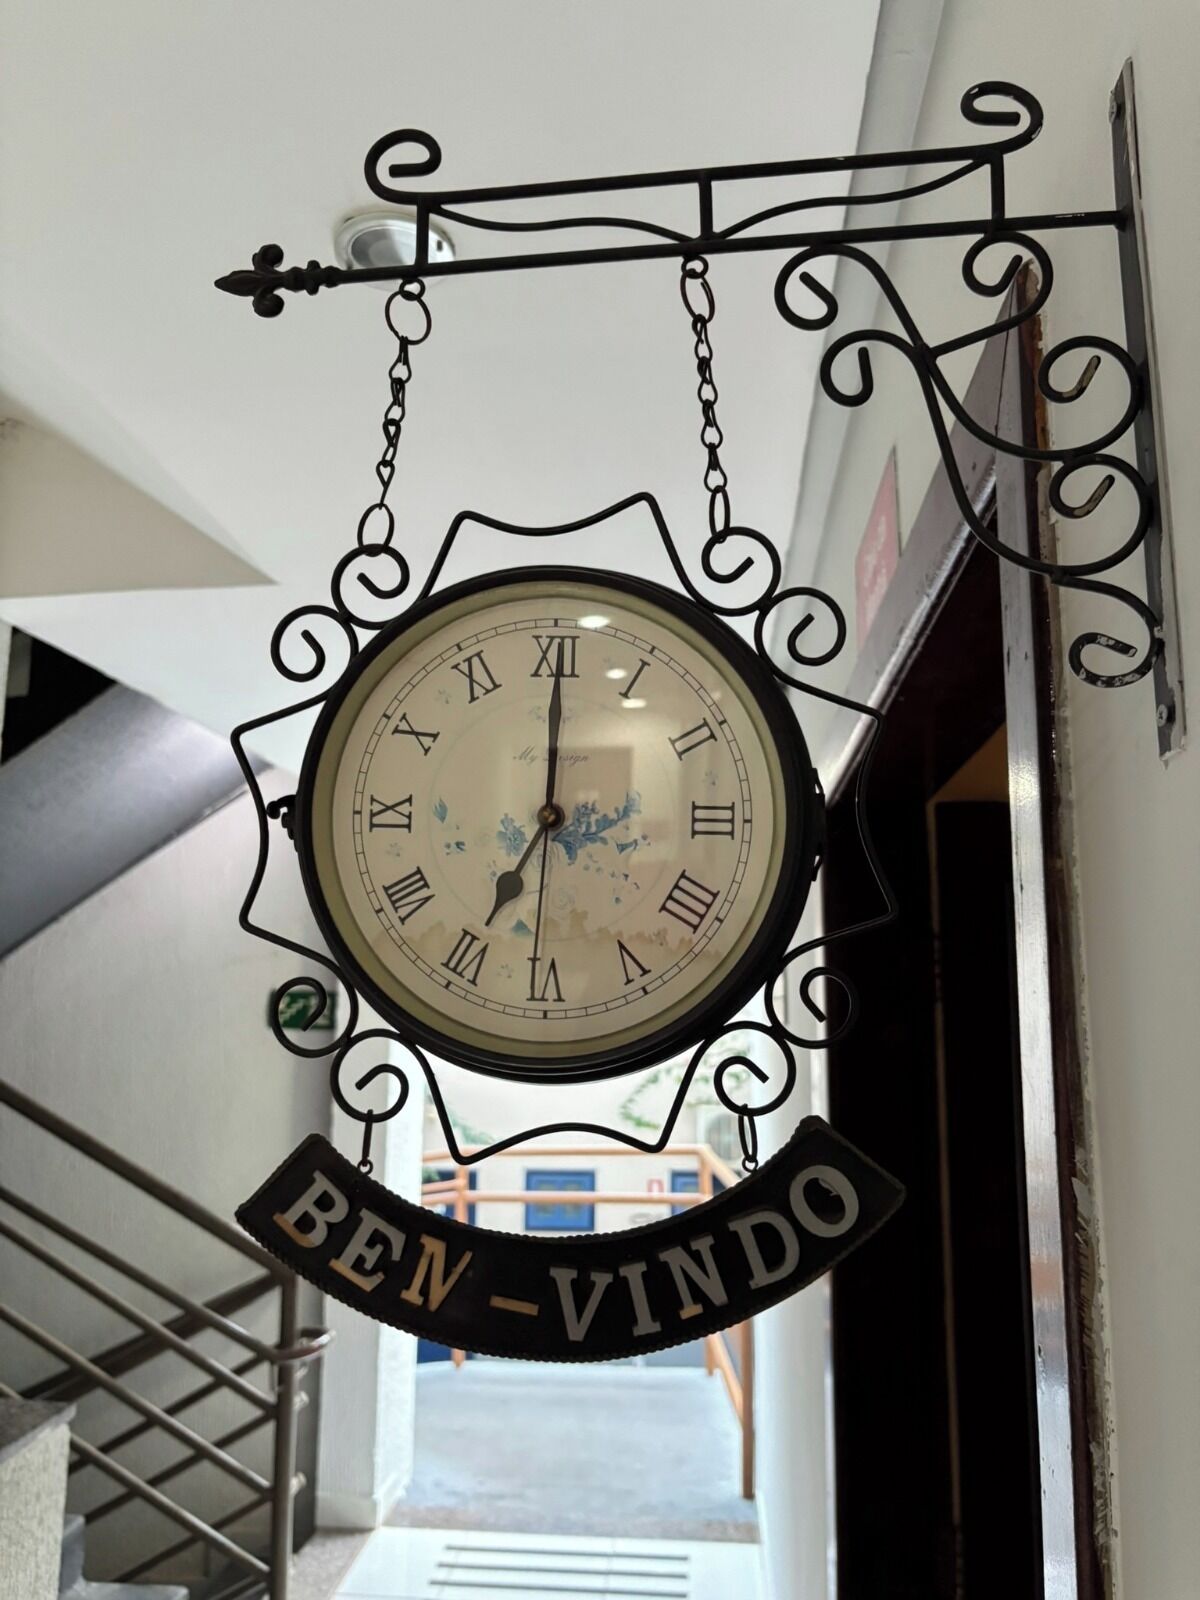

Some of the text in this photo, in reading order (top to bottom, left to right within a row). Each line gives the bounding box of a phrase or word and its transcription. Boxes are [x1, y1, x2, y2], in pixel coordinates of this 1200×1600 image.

[451, 650, 502, 703] XI
[530, 635, 580, 678] XII
[620, 659, 650, 698] I
[392, 713, 440, 756] X
[669, 718, 717, 760] II
[369, 794, 413, 833] IX
[691, 801, 735, 840] III
[382, 867, 435, 925] VIII
[658, 870, 720, 934] IIII
[441, 928, 489, 986] VII
[617, 940, 651, 985] V
[526, 957, 566, 1003] VI
